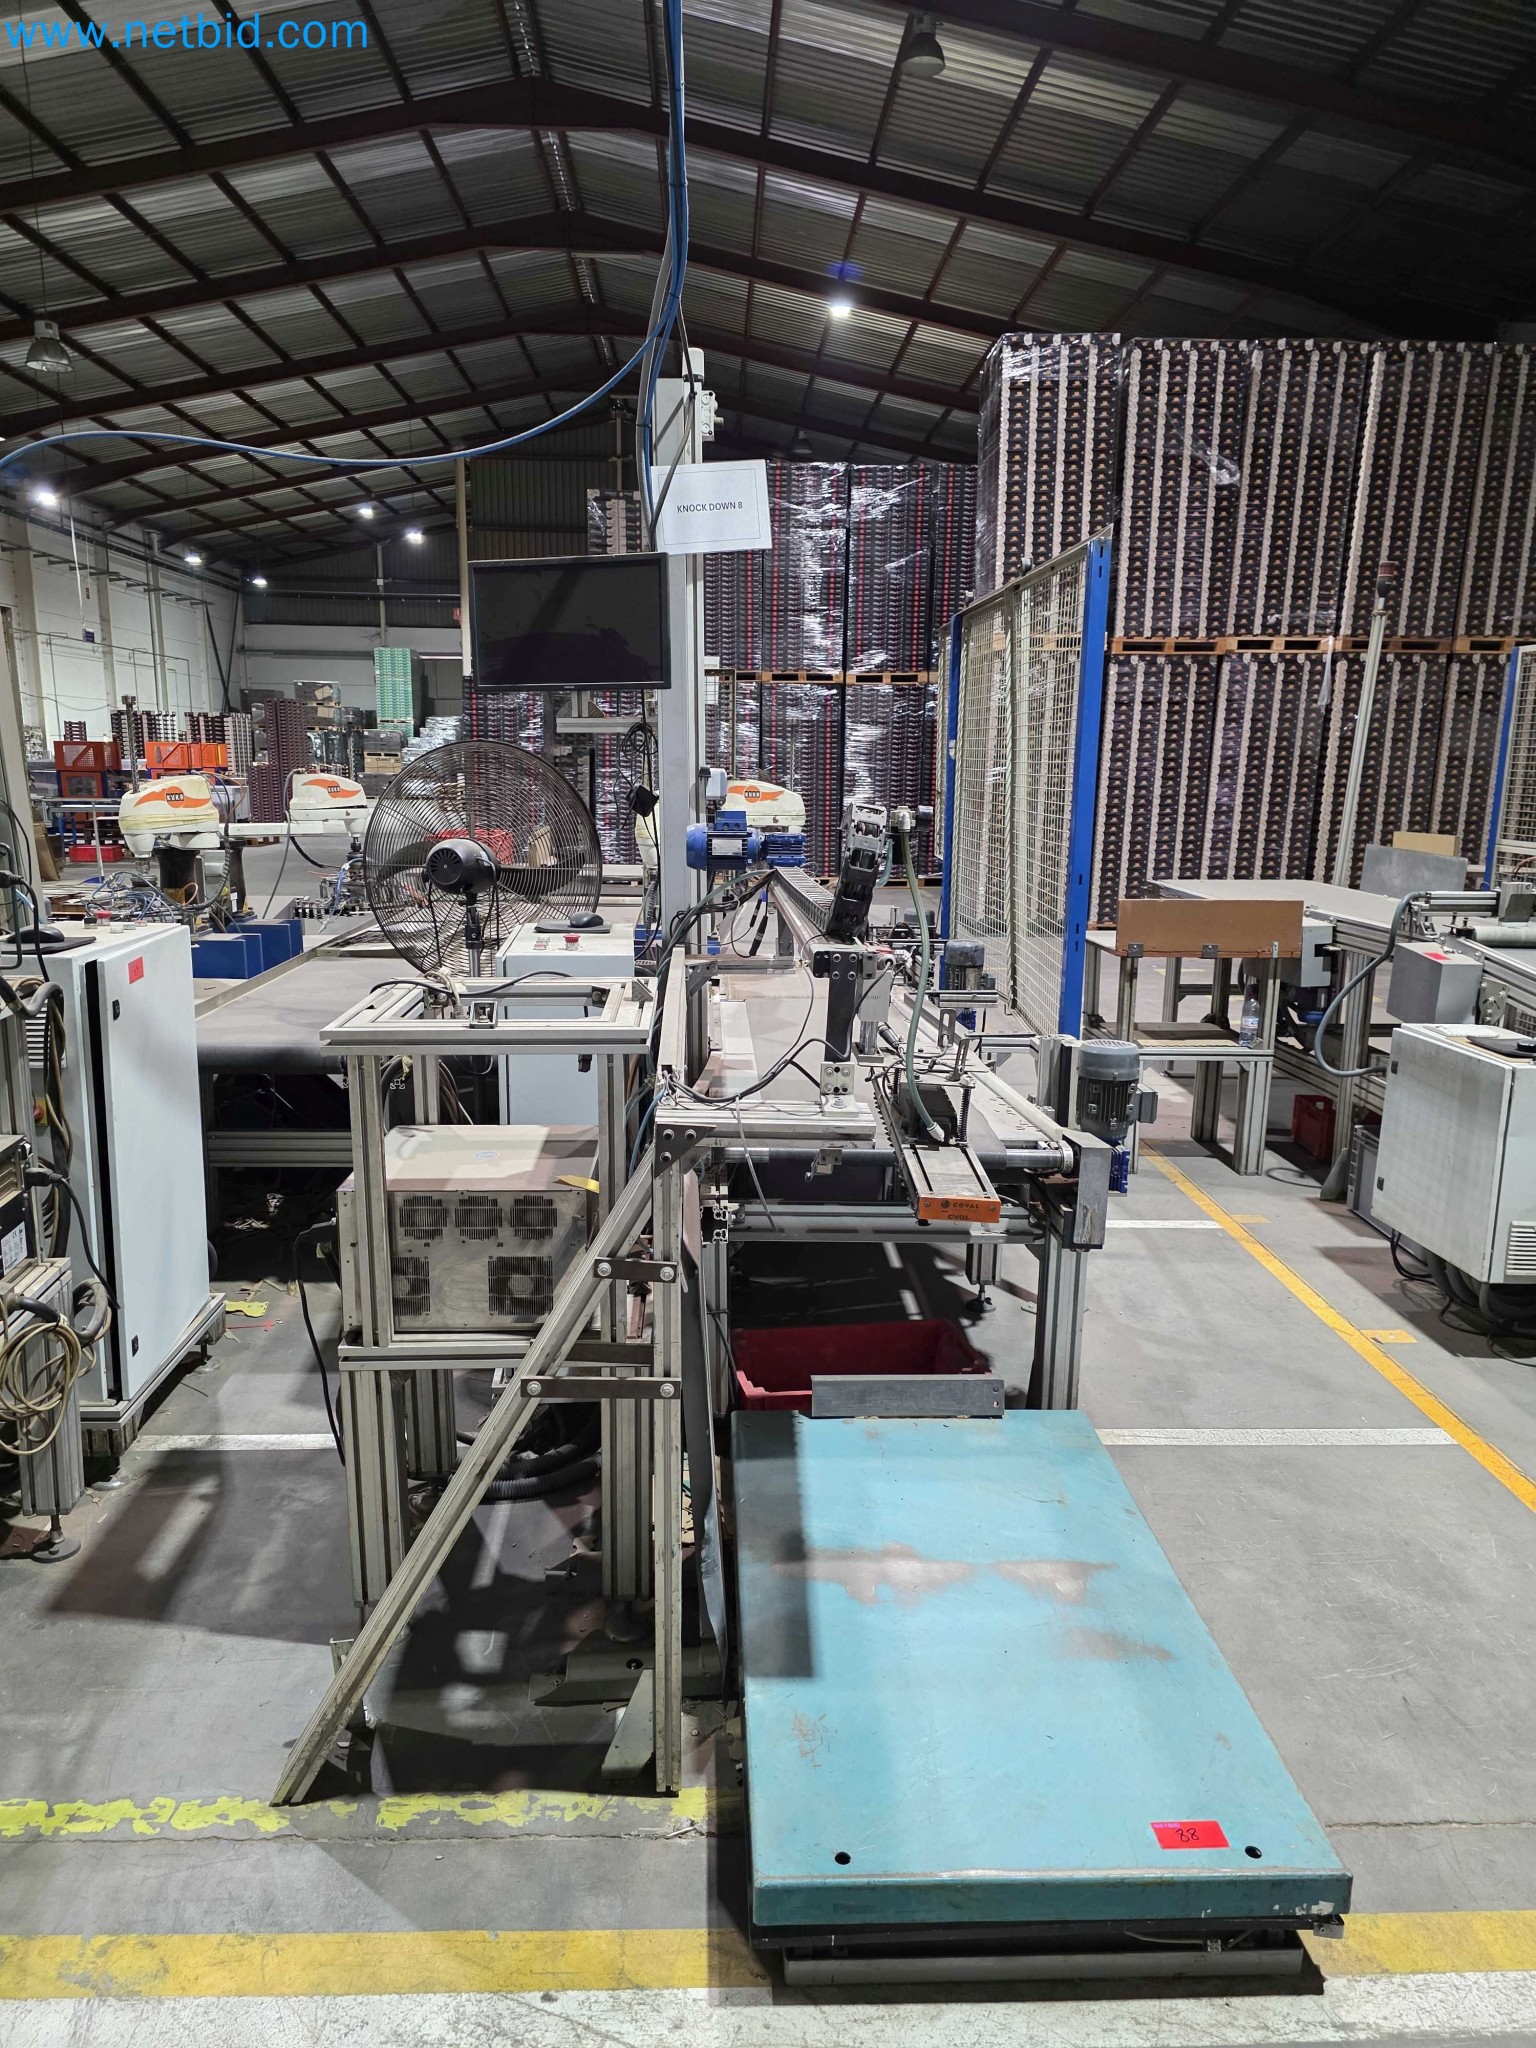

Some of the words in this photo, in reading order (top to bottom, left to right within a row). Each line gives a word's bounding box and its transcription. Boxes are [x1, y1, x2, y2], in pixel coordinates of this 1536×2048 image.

[677, 503, 708, 513] KNOCK
[709, 501, 736, 511] DOWN
[738, 501, 743, 509] 8
[1175, 1828, 1200, 1842] 88
